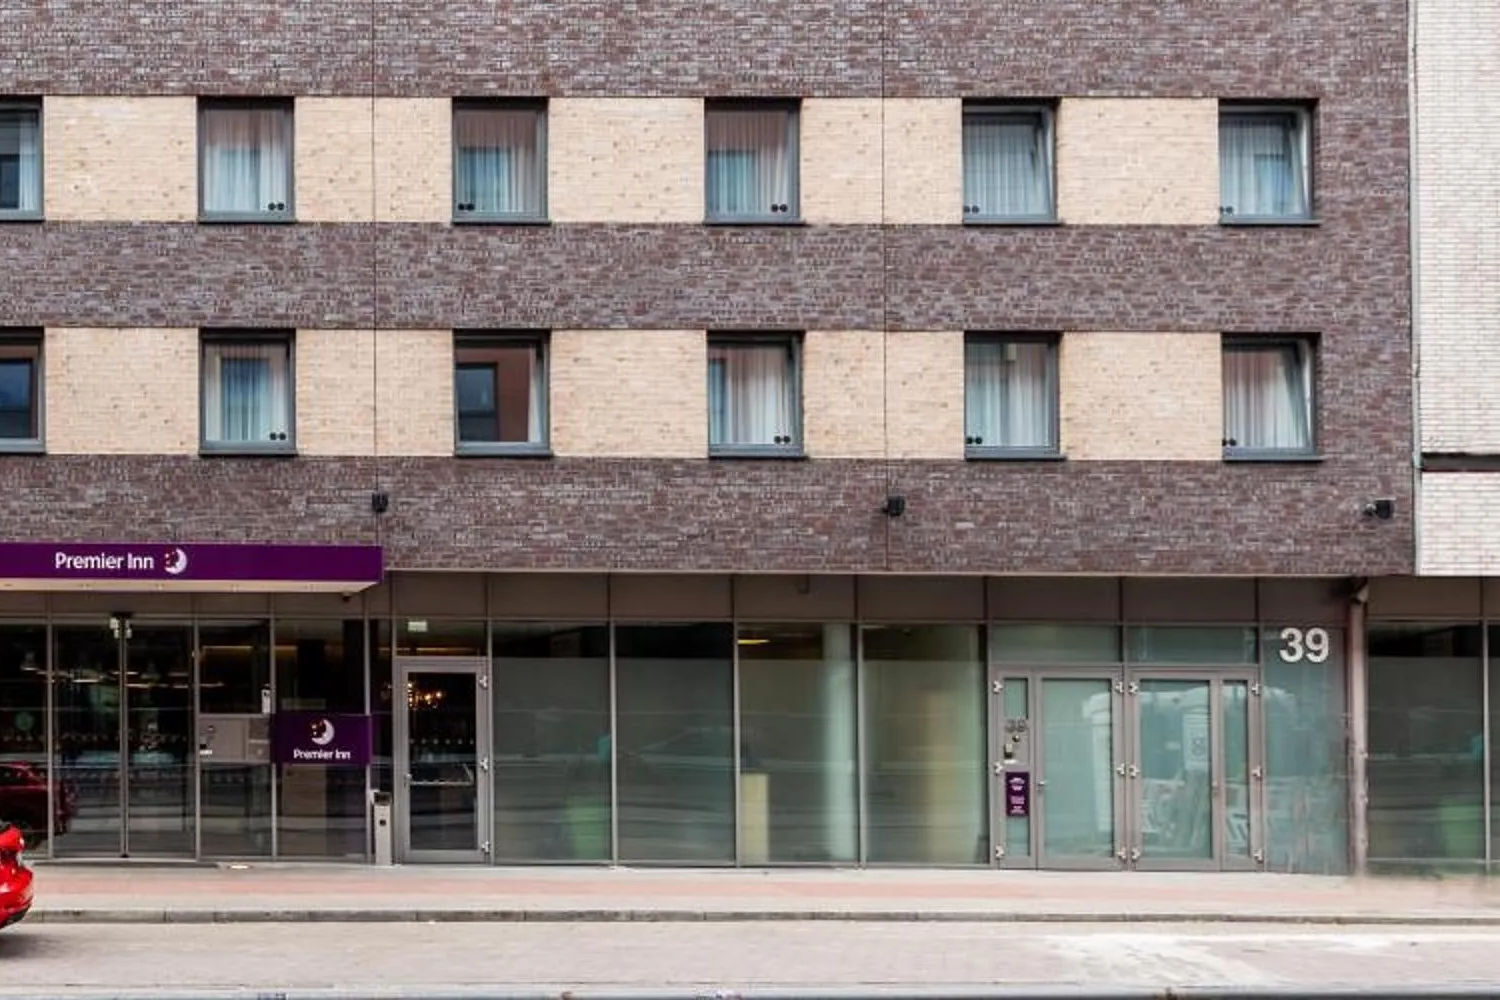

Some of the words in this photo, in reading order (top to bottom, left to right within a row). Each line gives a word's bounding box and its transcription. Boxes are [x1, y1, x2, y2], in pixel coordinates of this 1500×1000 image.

[55, 552, 124, 569] Premier
[127, 552, 154, 569] Inn
[1280, 627, 1329, 662] 39
[293, 749, 333, 759] Premier
